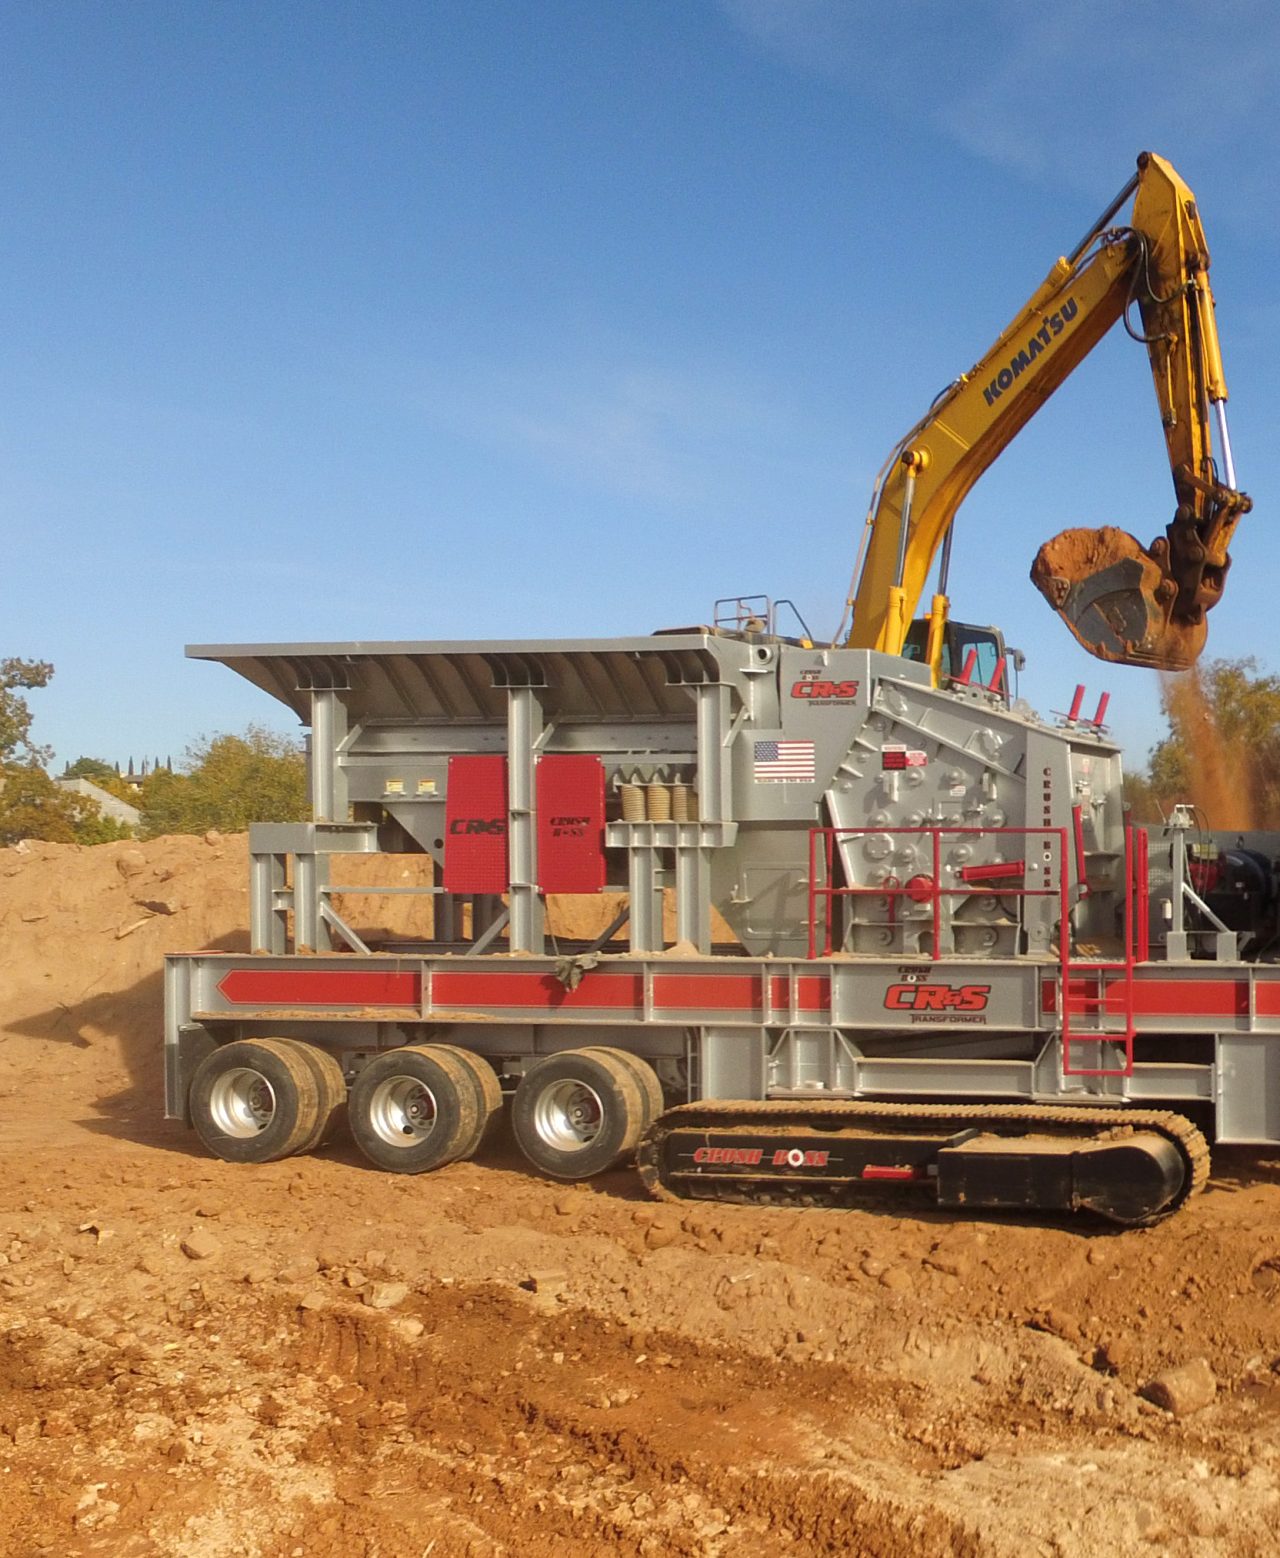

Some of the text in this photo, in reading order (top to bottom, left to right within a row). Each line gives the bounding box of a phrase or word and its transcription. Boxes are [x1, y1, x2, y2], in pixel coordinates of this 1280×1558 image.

[982, 297, 1078, 407] KOMATSU
[791, 681, 859, 698] CR&S
[1043, 767, 1052, 888] CRUSH BOSS
[898, 966, 932, 974] CRUSH
[901, 974, 929, 983] BOSS
[883, 984, 992, 1011] CR&S
[909, 1014, 987, 1024] TRANSFORMER
[693, 1147, 830, 1167] CRUSH BOSS
